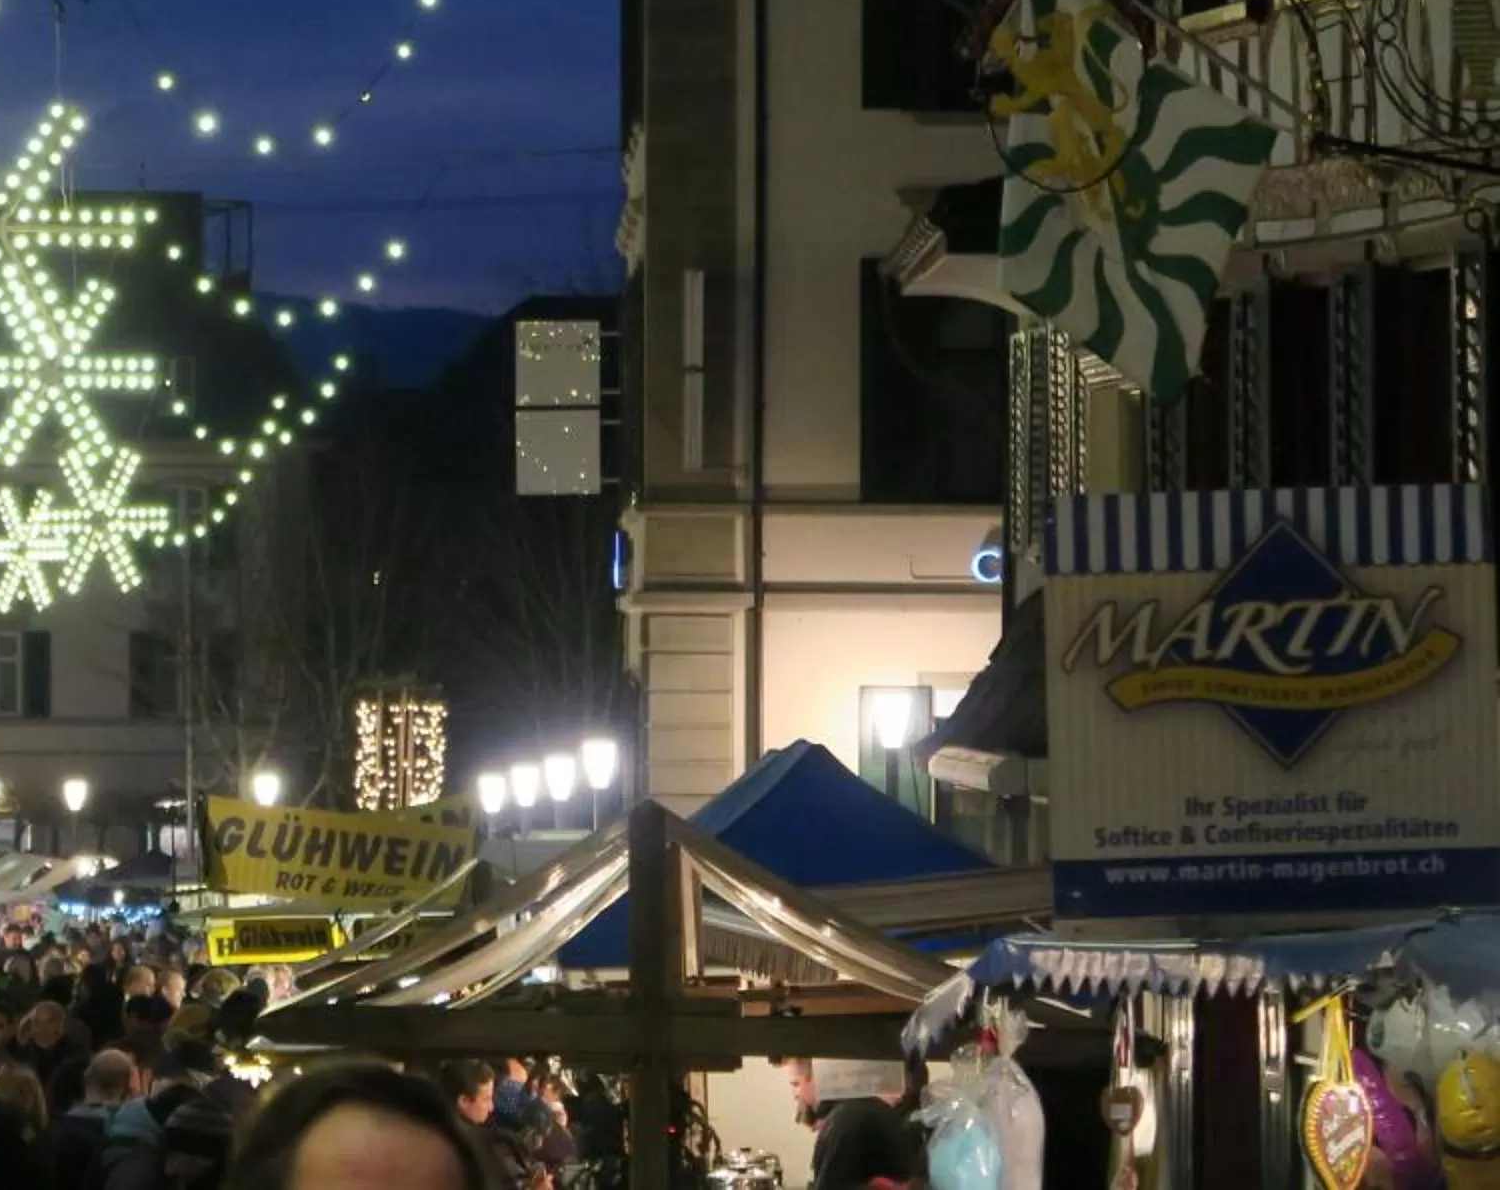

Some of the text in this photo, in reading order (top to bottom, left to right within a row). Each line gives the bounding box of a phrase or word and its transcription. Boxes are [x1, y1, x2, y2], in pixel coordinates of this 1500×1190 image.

[1062, 586, 1445, 676] MARTIN
[1185, 791, 1369, 821] Ihr Spezialist für
[214, 813, 466, 882] GLÜHWEIN
[1094, 818, 1460, 848] Softice & Confiseriespezialitäten
[276, 871, 316, 892] ROT
[1104, 853, 1447, 885] www.martin-magenbrot.ch
